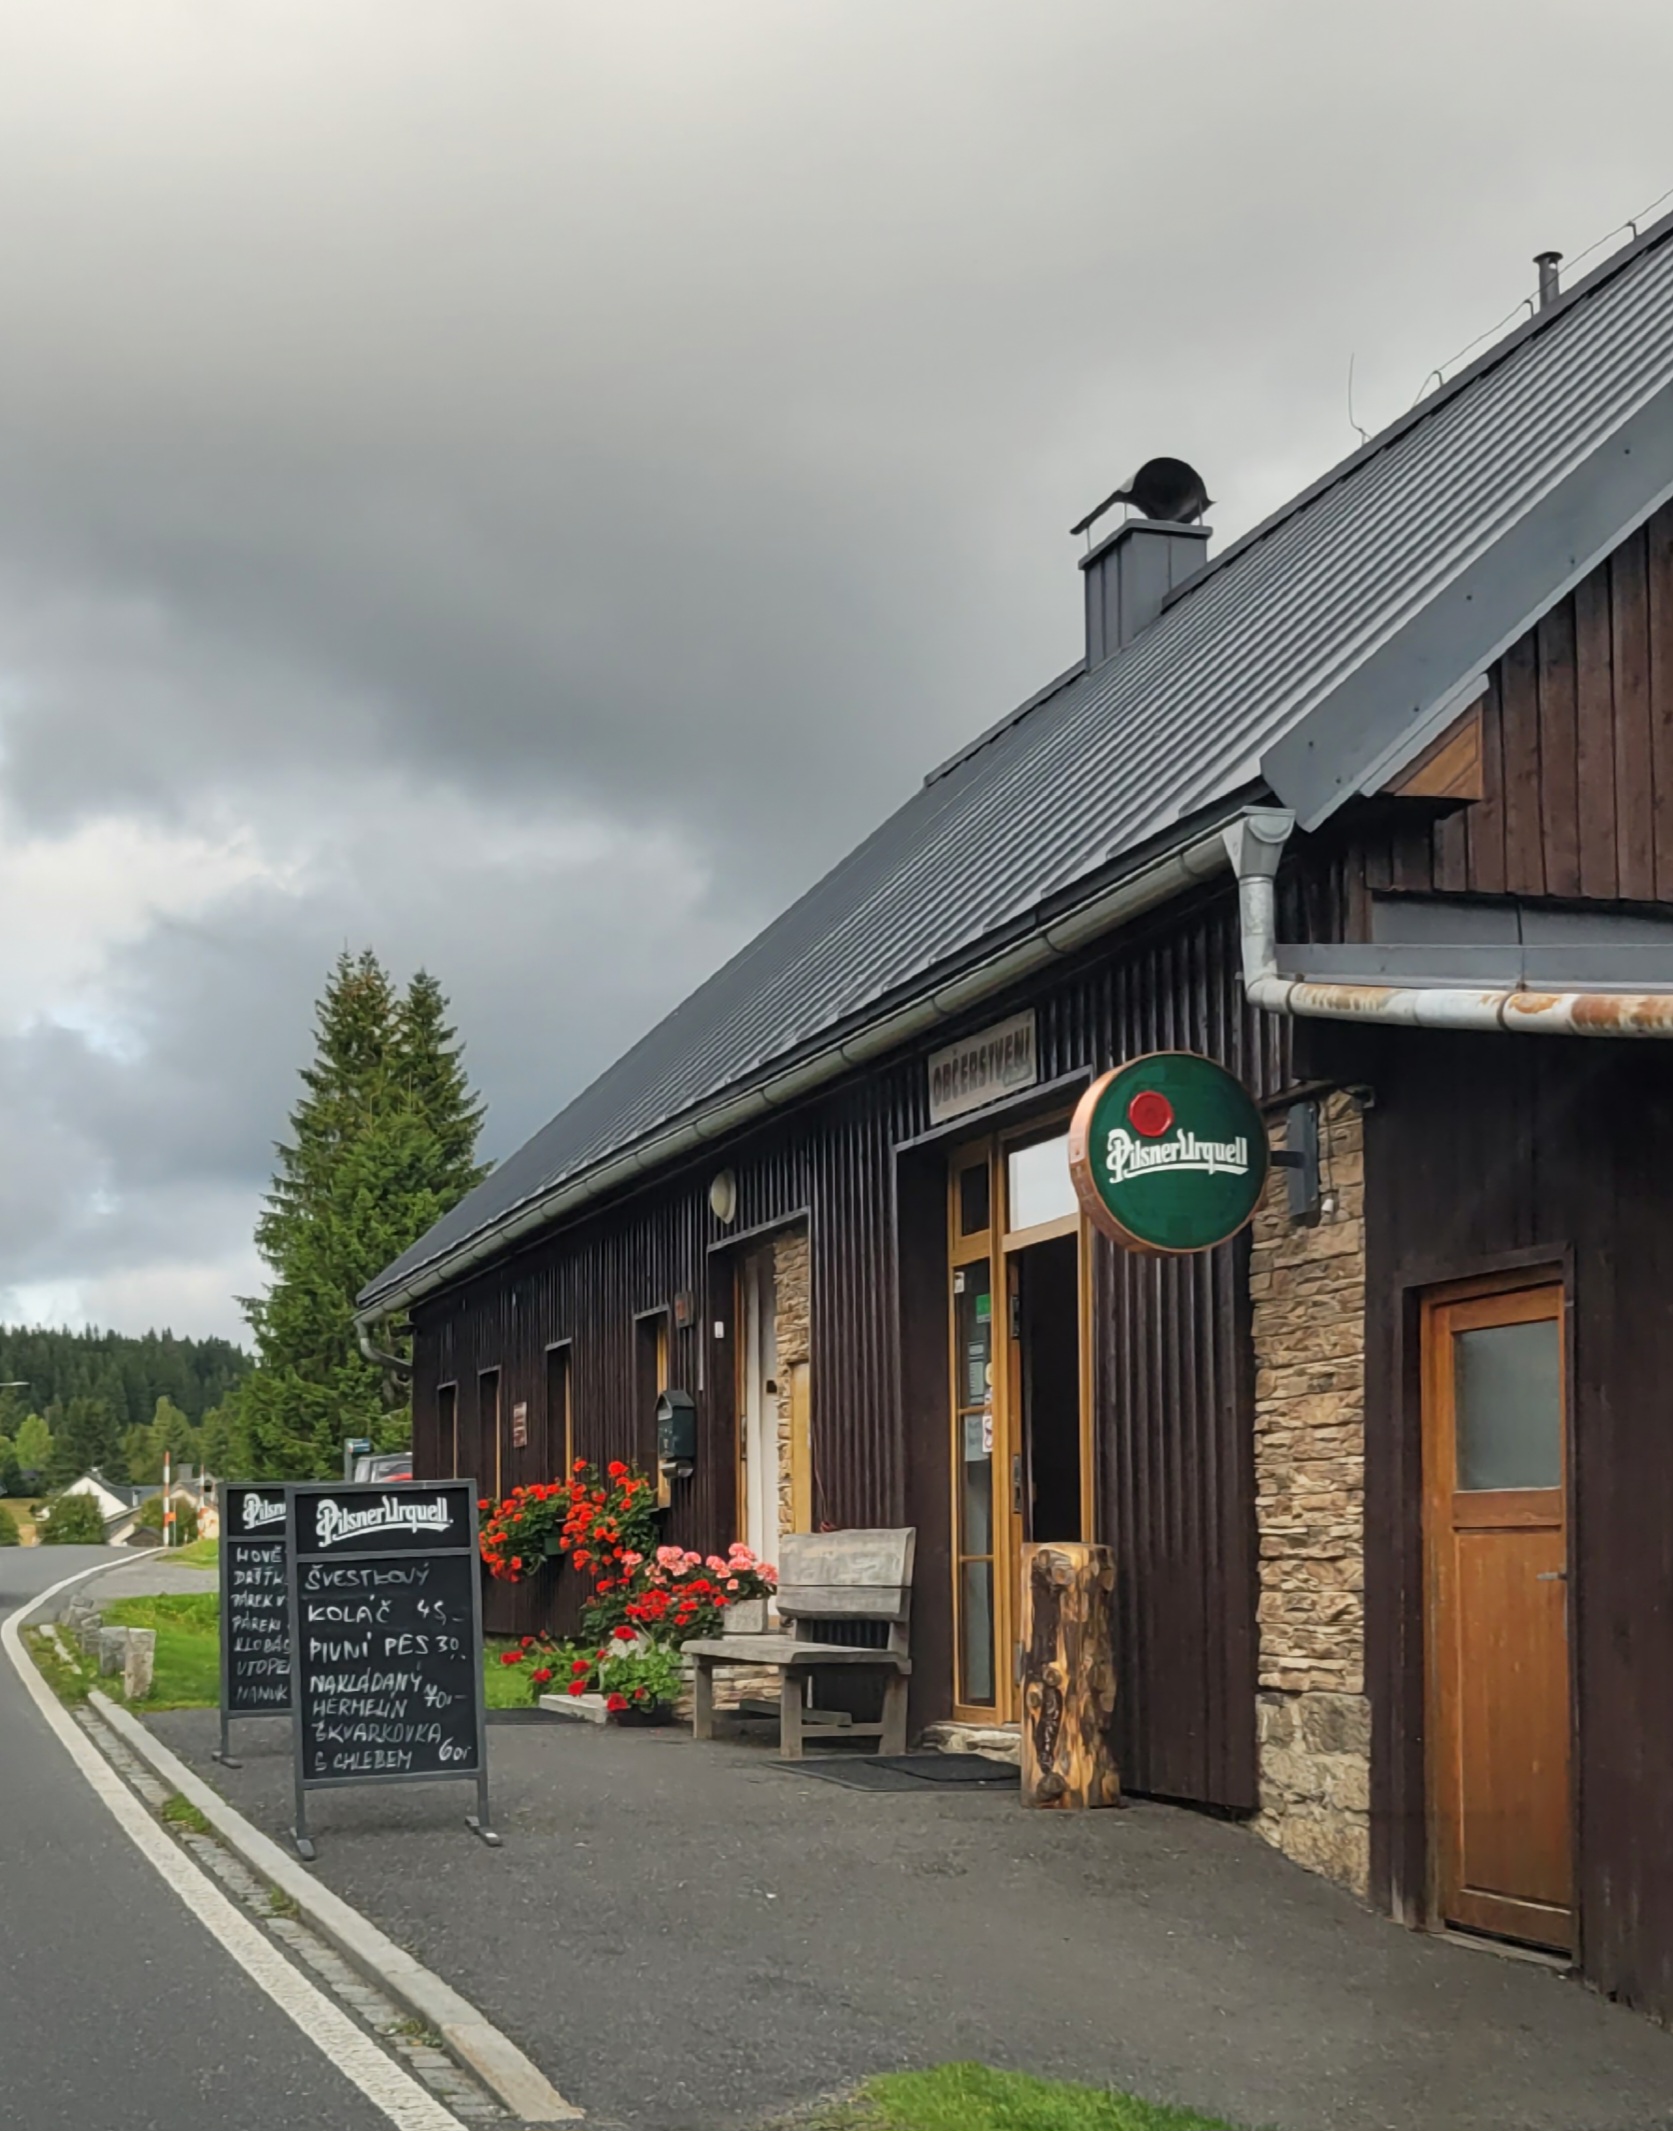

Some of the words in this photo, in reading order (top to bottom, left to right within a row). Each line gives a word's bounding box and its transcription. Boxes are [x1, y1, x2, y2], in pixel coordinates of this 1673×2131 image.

[1106, 1128, 1179, 1183] Pilsner
[1177, 1128, 1247, 1175] Urquell
[316, 1499, 384, 1547] Pilsner
[381, 1495, 450, 1533] Urquell
[236, 1545, 283, 1563] HOVĚ
[305, 1563, 430, 1590] ŠVESTKOVÝ
[308, 1594, 392, 1623] KOLÁČ
[310, 1631, 372, 1663] PIVNÍ
[385, 1634, 429, 1656] PES
[310, 1661, 422, 1696] NAKLÁDANÝ
[333, 1749, 413, 1770] CHLEBEM
